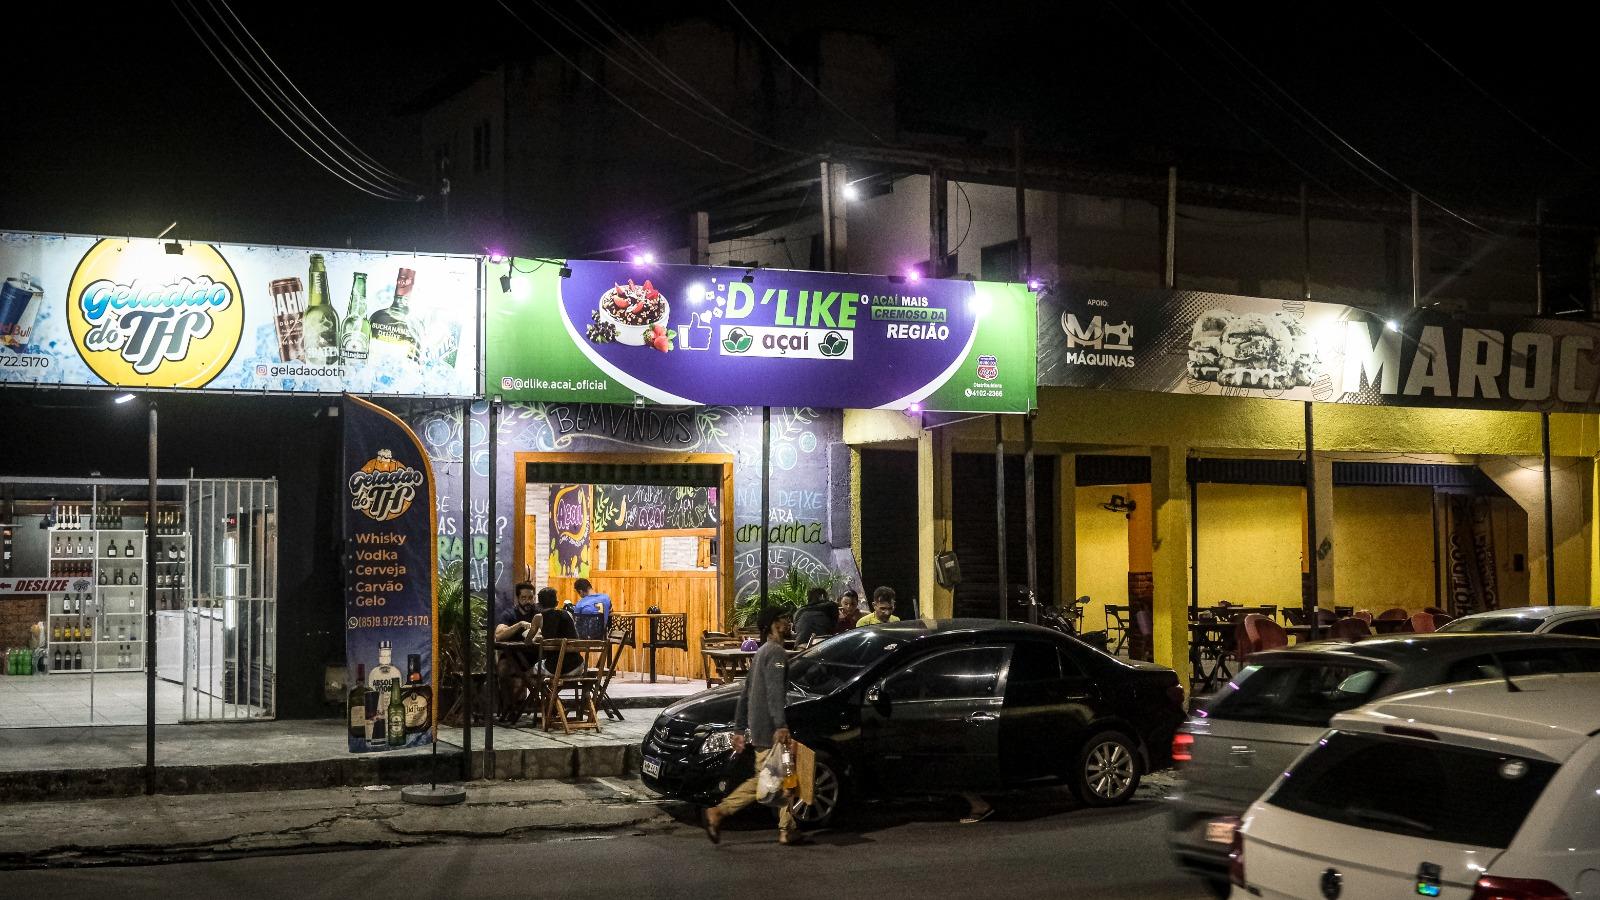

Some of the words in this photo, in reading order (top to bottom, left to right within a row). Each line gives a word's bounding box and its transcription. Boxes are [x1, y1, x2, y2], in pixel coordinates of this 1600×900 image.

[82, 279, 228, 320] Geladão
[861, 294, 869, 304] O
[872, 293, 898, 306] AÇAÍ
[901, 296, 929, 307] MAIS
[875, 308, 928, 320] CREMOSO
[931, 310, 945, 321] DA
[88, 316, 118, 345] do
[119, 307, 206, 367] TH
[886, 322, 950, 341] REGIÃO
[762, 331, 809, 354] açaí
[1066, 350, 1135, 368] MÁQUINAS
[1341, 320, 1600, 403] MAROC
[270, 364, 345, 377] geladaodoth
[514, 378, 607, 390] @dlike.acai_oficial
[736, 482, 763, 507] NÃ
[778, 490, 823, 509] DEIXE
[736, 520, 827, 545] amanhã
[356, 533, 406, 546] Whisky
[356, 550, 398, 561] Vodka
[356, 565, 406, 577] Cerveja
[15, 579, 70, 592] DESLIZE
[356, 580, 404, 592] Carvão
[356, 596, 386, 607] Gelo
